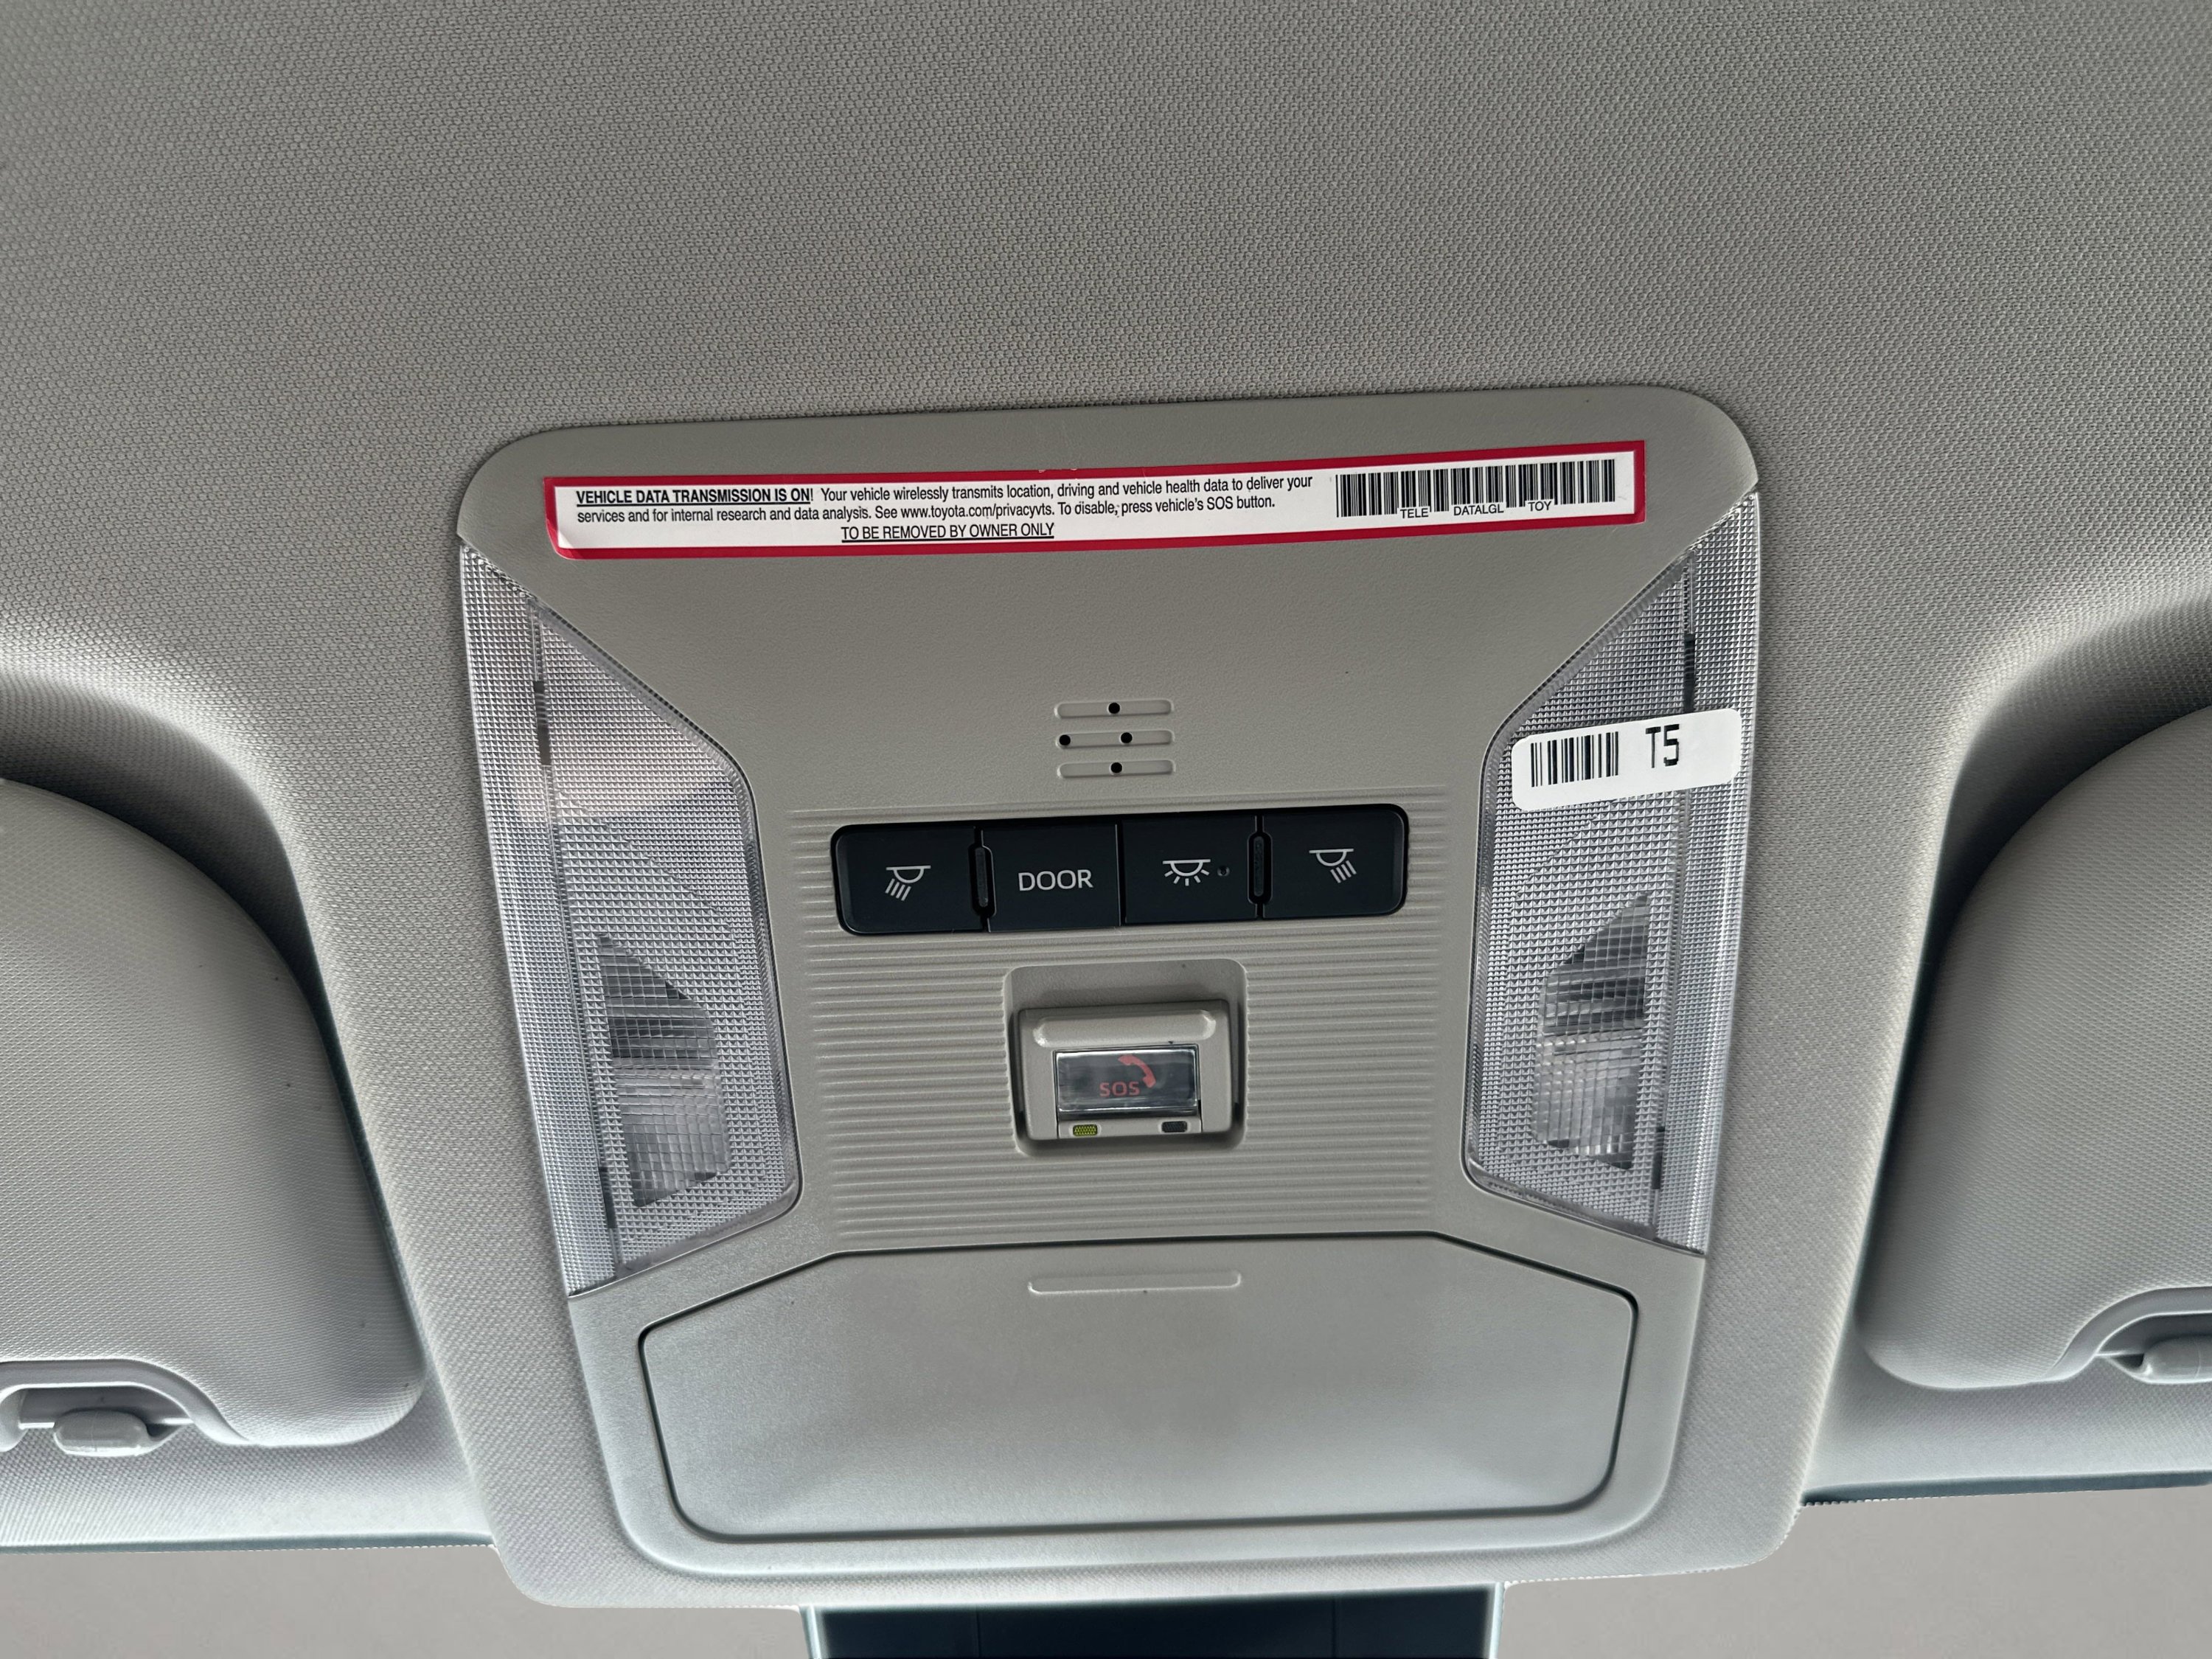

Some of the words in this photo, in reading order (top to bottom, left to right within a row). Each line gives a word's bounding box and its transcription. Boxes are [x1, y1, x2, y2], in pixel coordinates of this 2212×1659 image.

[576, 490, 633, 504] VEHICLE
[636, 490, 670, 503] DATA
[672, 488, 771, 503] TRANSMISSION
[774, 488, 787, 501] IS
[790, 487, 814, 501] ON!
[821, 487, 847, 501] Your
[850, 487, 890, 501] vehicle
[893, 486, 949, 502] wirelessly
[951, 484, 1004, 499] transmits
[1006, 484, 1054, 498] location,
[1057, 483, 1094, 499] driving
[1098, 481, 1119, 495] and
[1122, 481, 1162, 495] vehicle
[1166, 479, 1200, 493] health
[1203, 478, 1228, 492] data
[1231, 478, 1242, 490] to
[1246, 476, 1284, 490] deliver
[1287, 476, 1312, 491] your
[577, 509, 625, 523] services
[628, 509, 650, 522] and
[653, 508, 668, 522] for
[671, 508, 713, 521] internal
[717, 507, 767, 521] research
[770, 507, 791, 521] and
[794, 506, 819, 520] data
[822, 505, 872, 522] analysis.
[874, 505, 897, 519] See
[900, 503, 1054, 521] www.toyota.com/privacyvts.
[1057, 501, 1071, 515] To
[1074, 501, 1118, 515] disable,
[1121, 501, 1152, 517] press
[1206, 496, 1234, 509] SOS
[1237, 495, 1276, 509] button.
[1399, 507, 1429, 518] TELE
[1453, 503, 1504, 516] DATALGL
[1527, 500, 1552, 512] TOY
[841, 526, 859, 540] TO
[862, 526, 880, 539] BE
[883, 525, 946, 539] REMOVED
[949, 524, 967, 538] BY
[969, 524, 1018, 538] OWNER
[1020, 522, 1054, 536] ONLY
[1645, 723, 1680, 768] T5
[1018, 869, 1093, 891] DOOR
[1099, 1081, 1141, 1097] SOS
